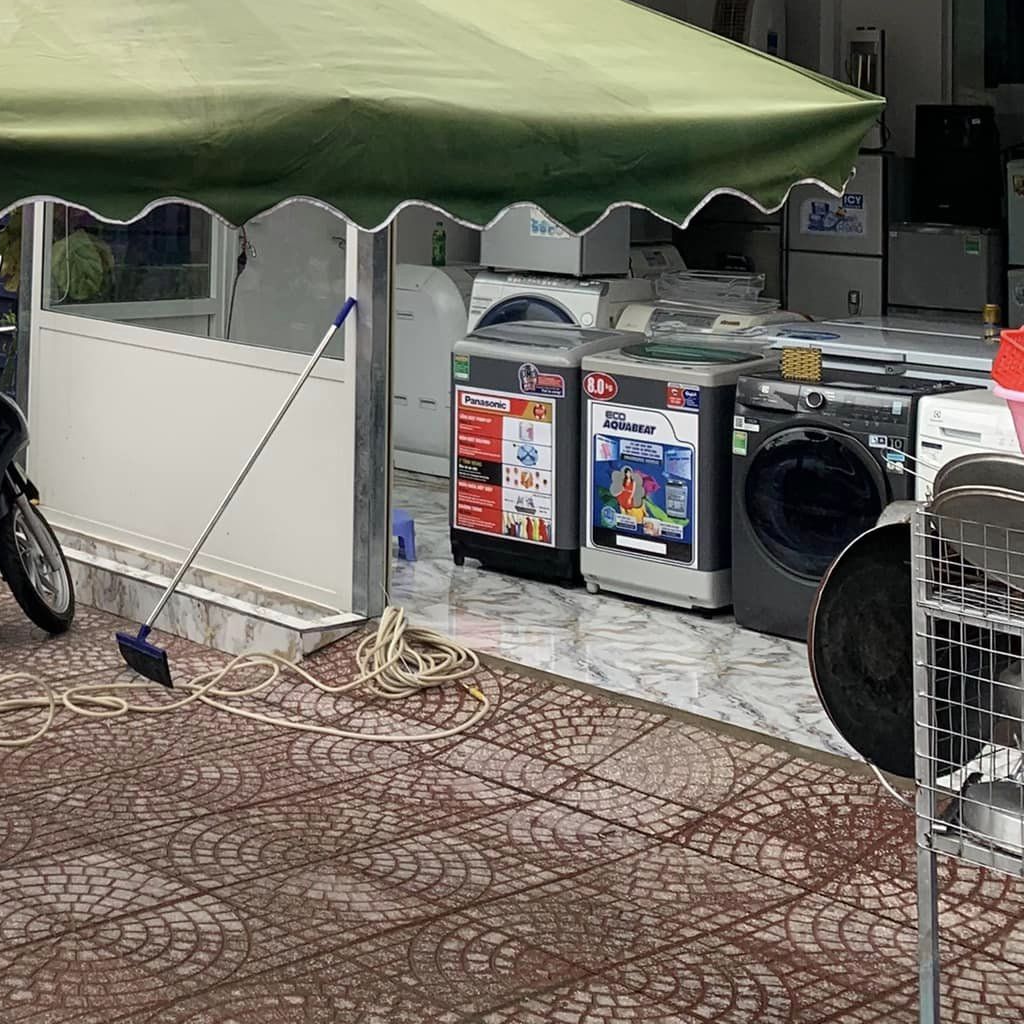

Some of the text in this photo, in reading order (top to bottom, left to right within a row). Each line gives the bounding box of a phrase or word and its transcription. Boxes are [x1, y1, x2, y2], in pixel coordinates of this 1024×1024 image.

[587, 376, 605, 395] 8.0
[464, 395, 508, 410] Panasonic
[602, 419, 657, 435] AQUABEAT
